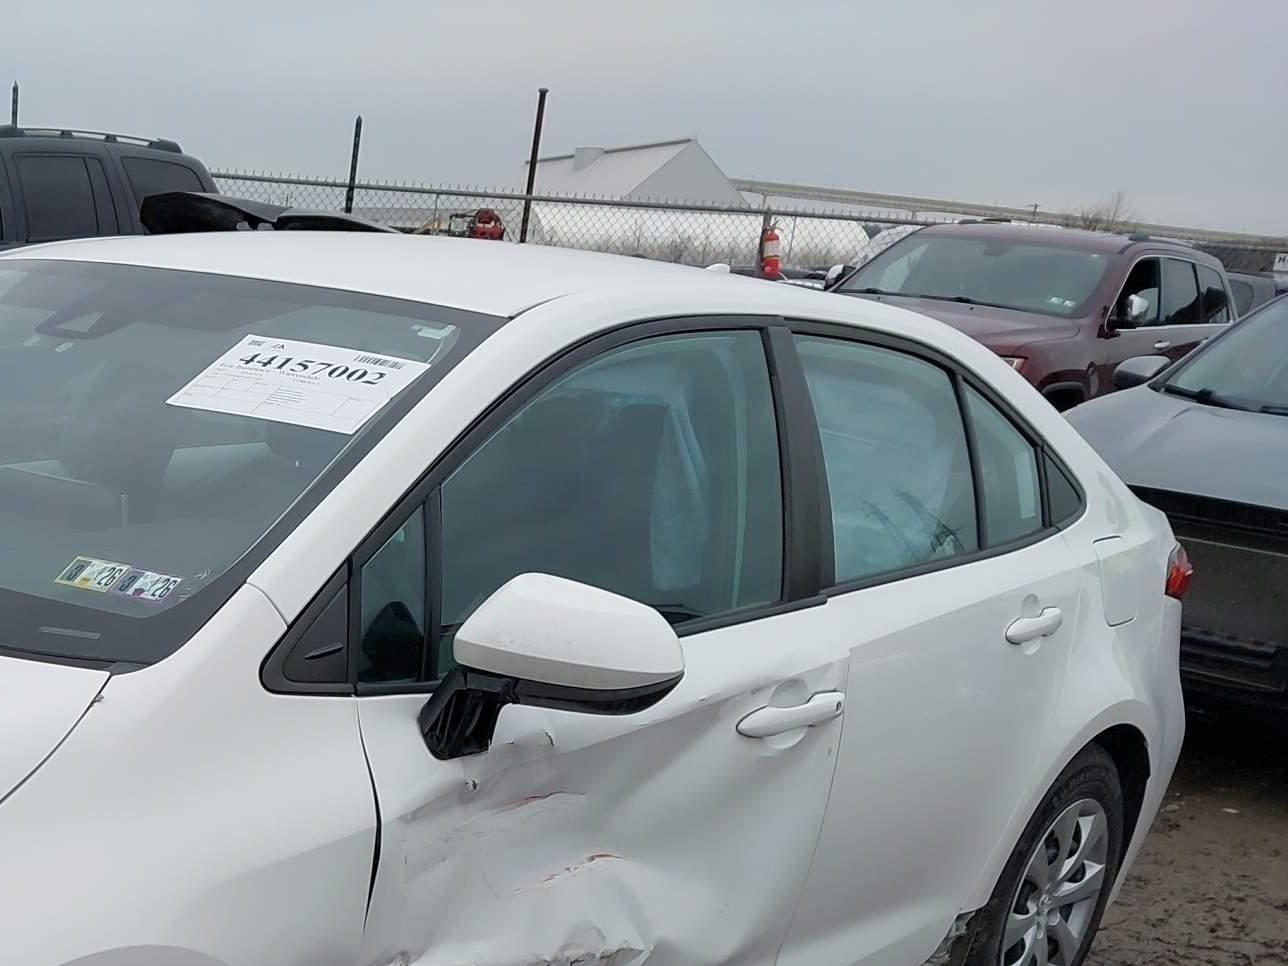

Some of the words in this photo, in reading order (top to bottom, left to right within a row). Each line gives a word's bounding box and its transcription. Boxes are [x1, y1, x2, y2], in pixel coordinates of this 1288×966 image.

[239, 352, 387, 386] 44157002
[66, 564, 85, 581] 3
[97, 566, 123, 587] 26
[119, 574, 137, 592] 3
[151, 577, 178, 598] 26
